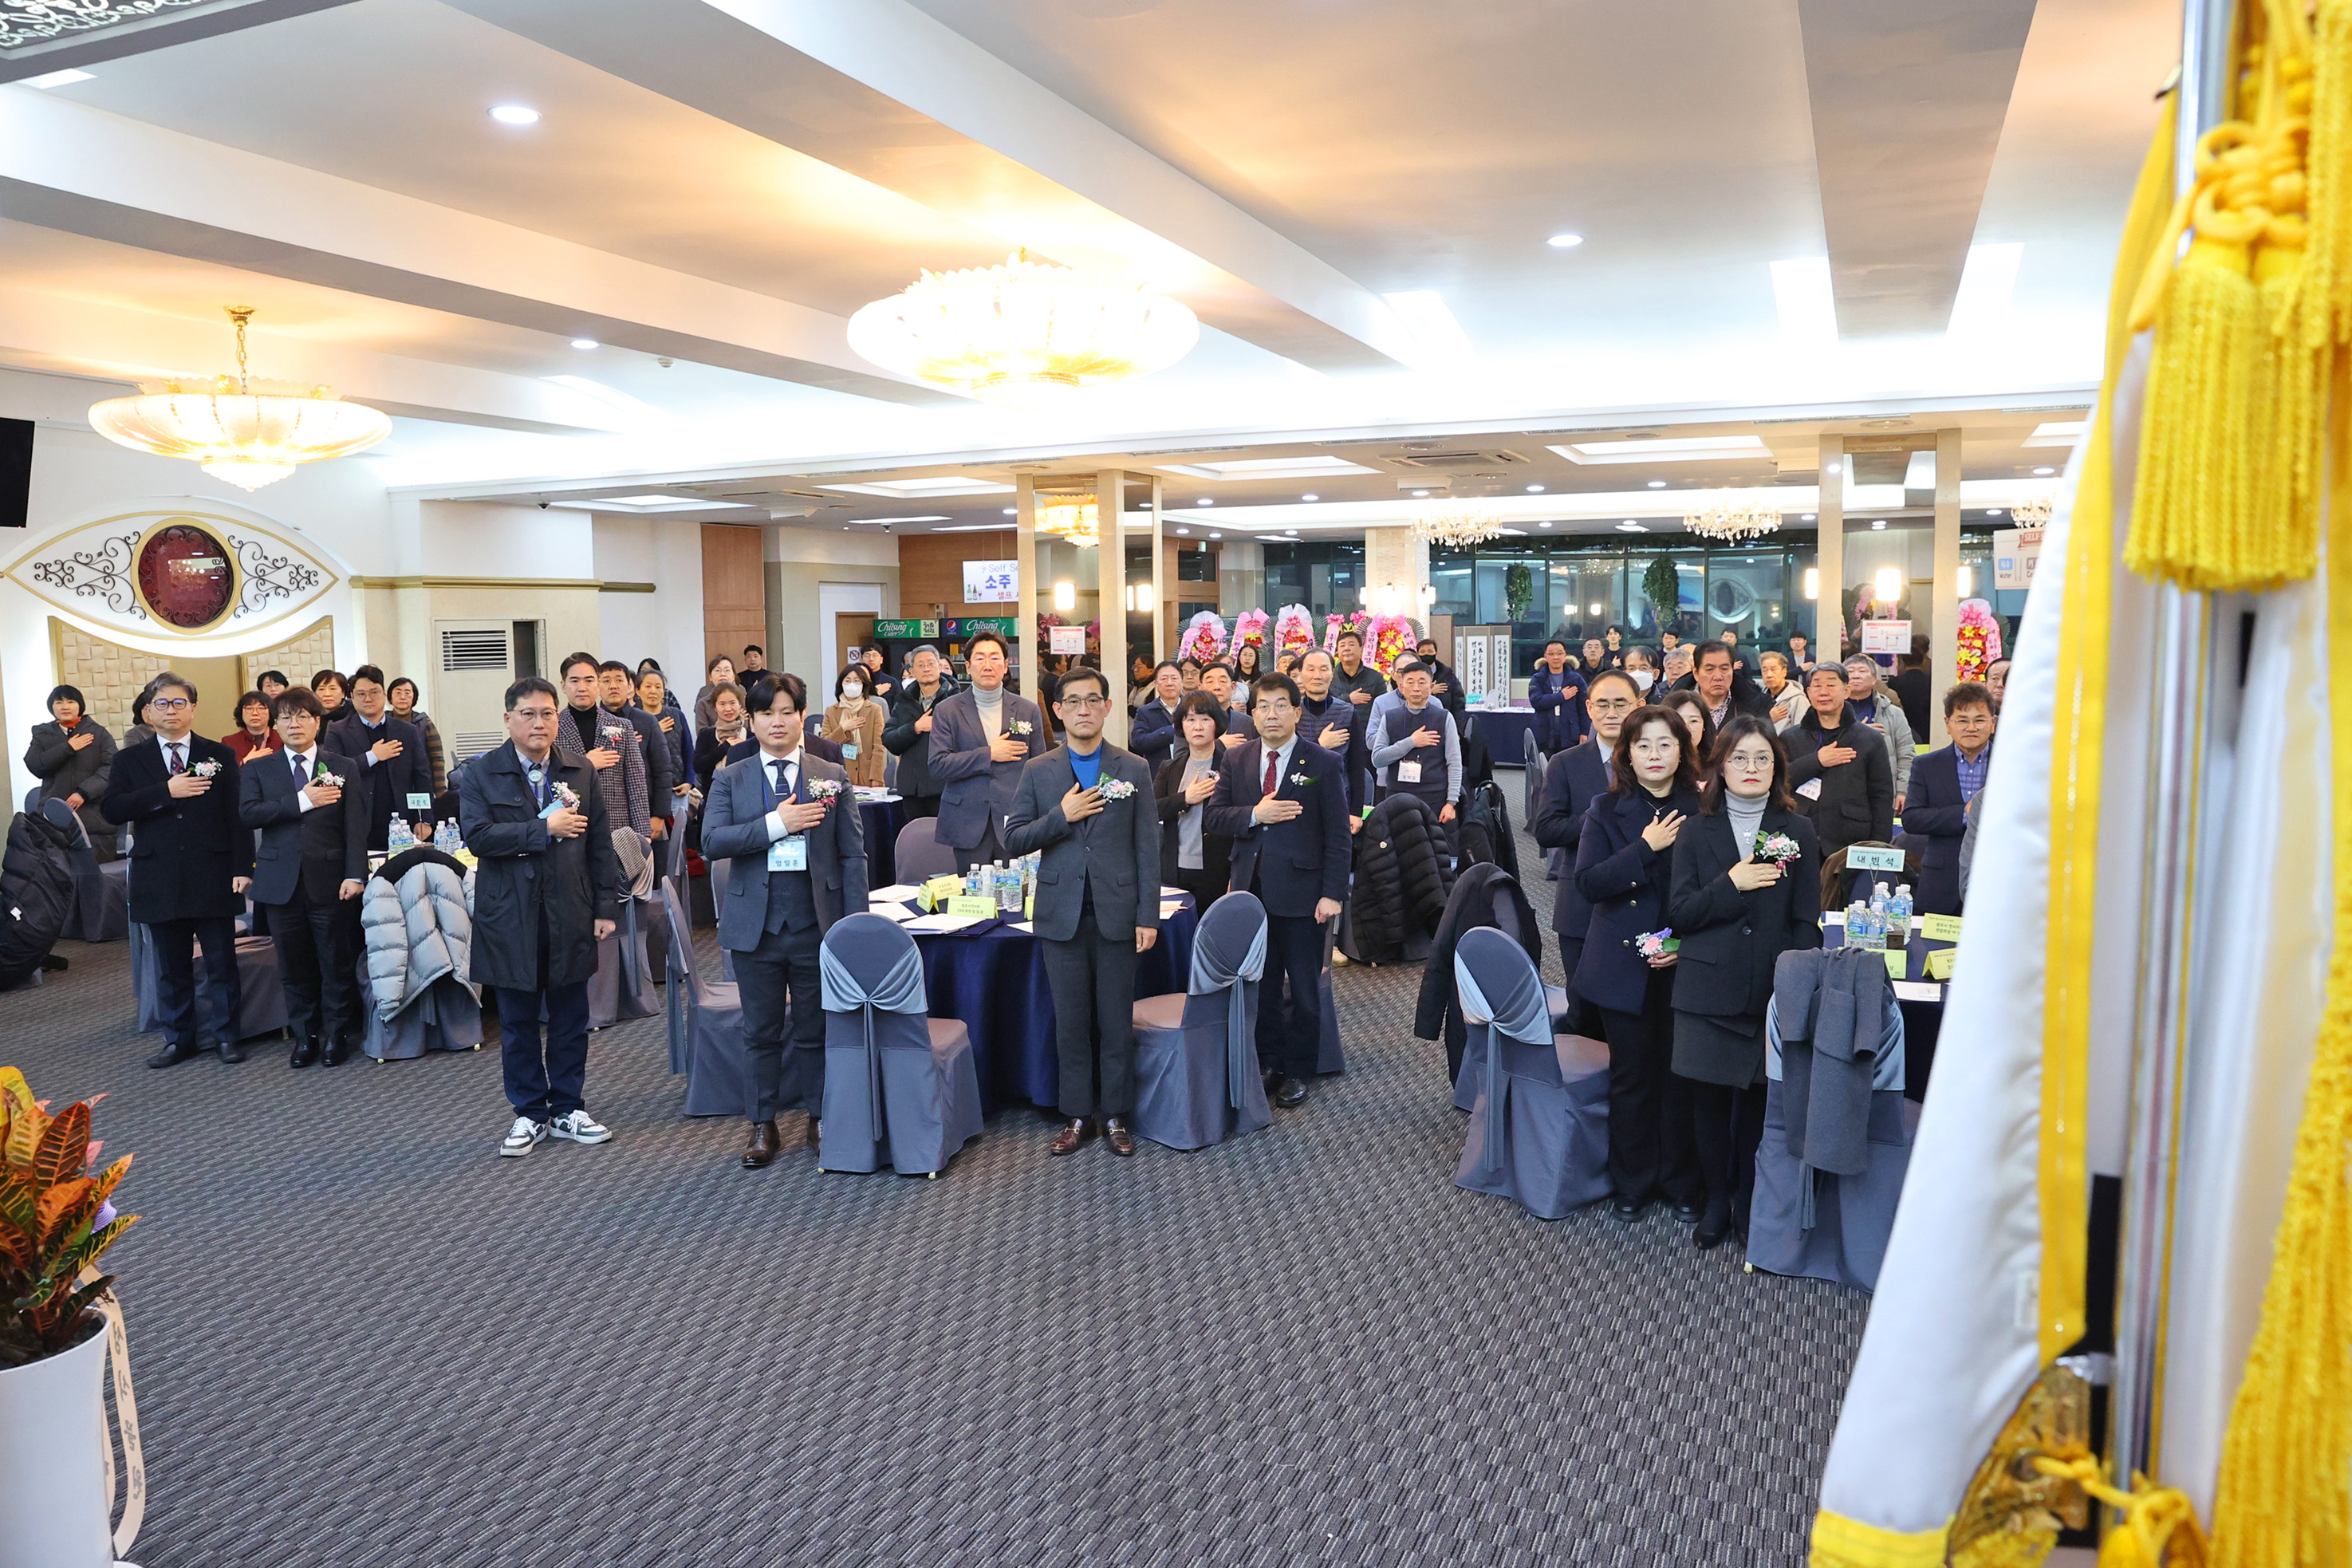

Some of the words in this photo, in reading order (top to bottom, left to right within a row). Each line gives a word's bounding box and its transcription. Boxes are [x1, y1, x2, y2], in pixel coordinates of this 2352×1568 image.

[2024, 533, 2039, 542] SELF
[988, 563, 1006, 573] Self
[985, 574, 1011, 589] 소주
[998, 591, 1013, 600] 셀프
